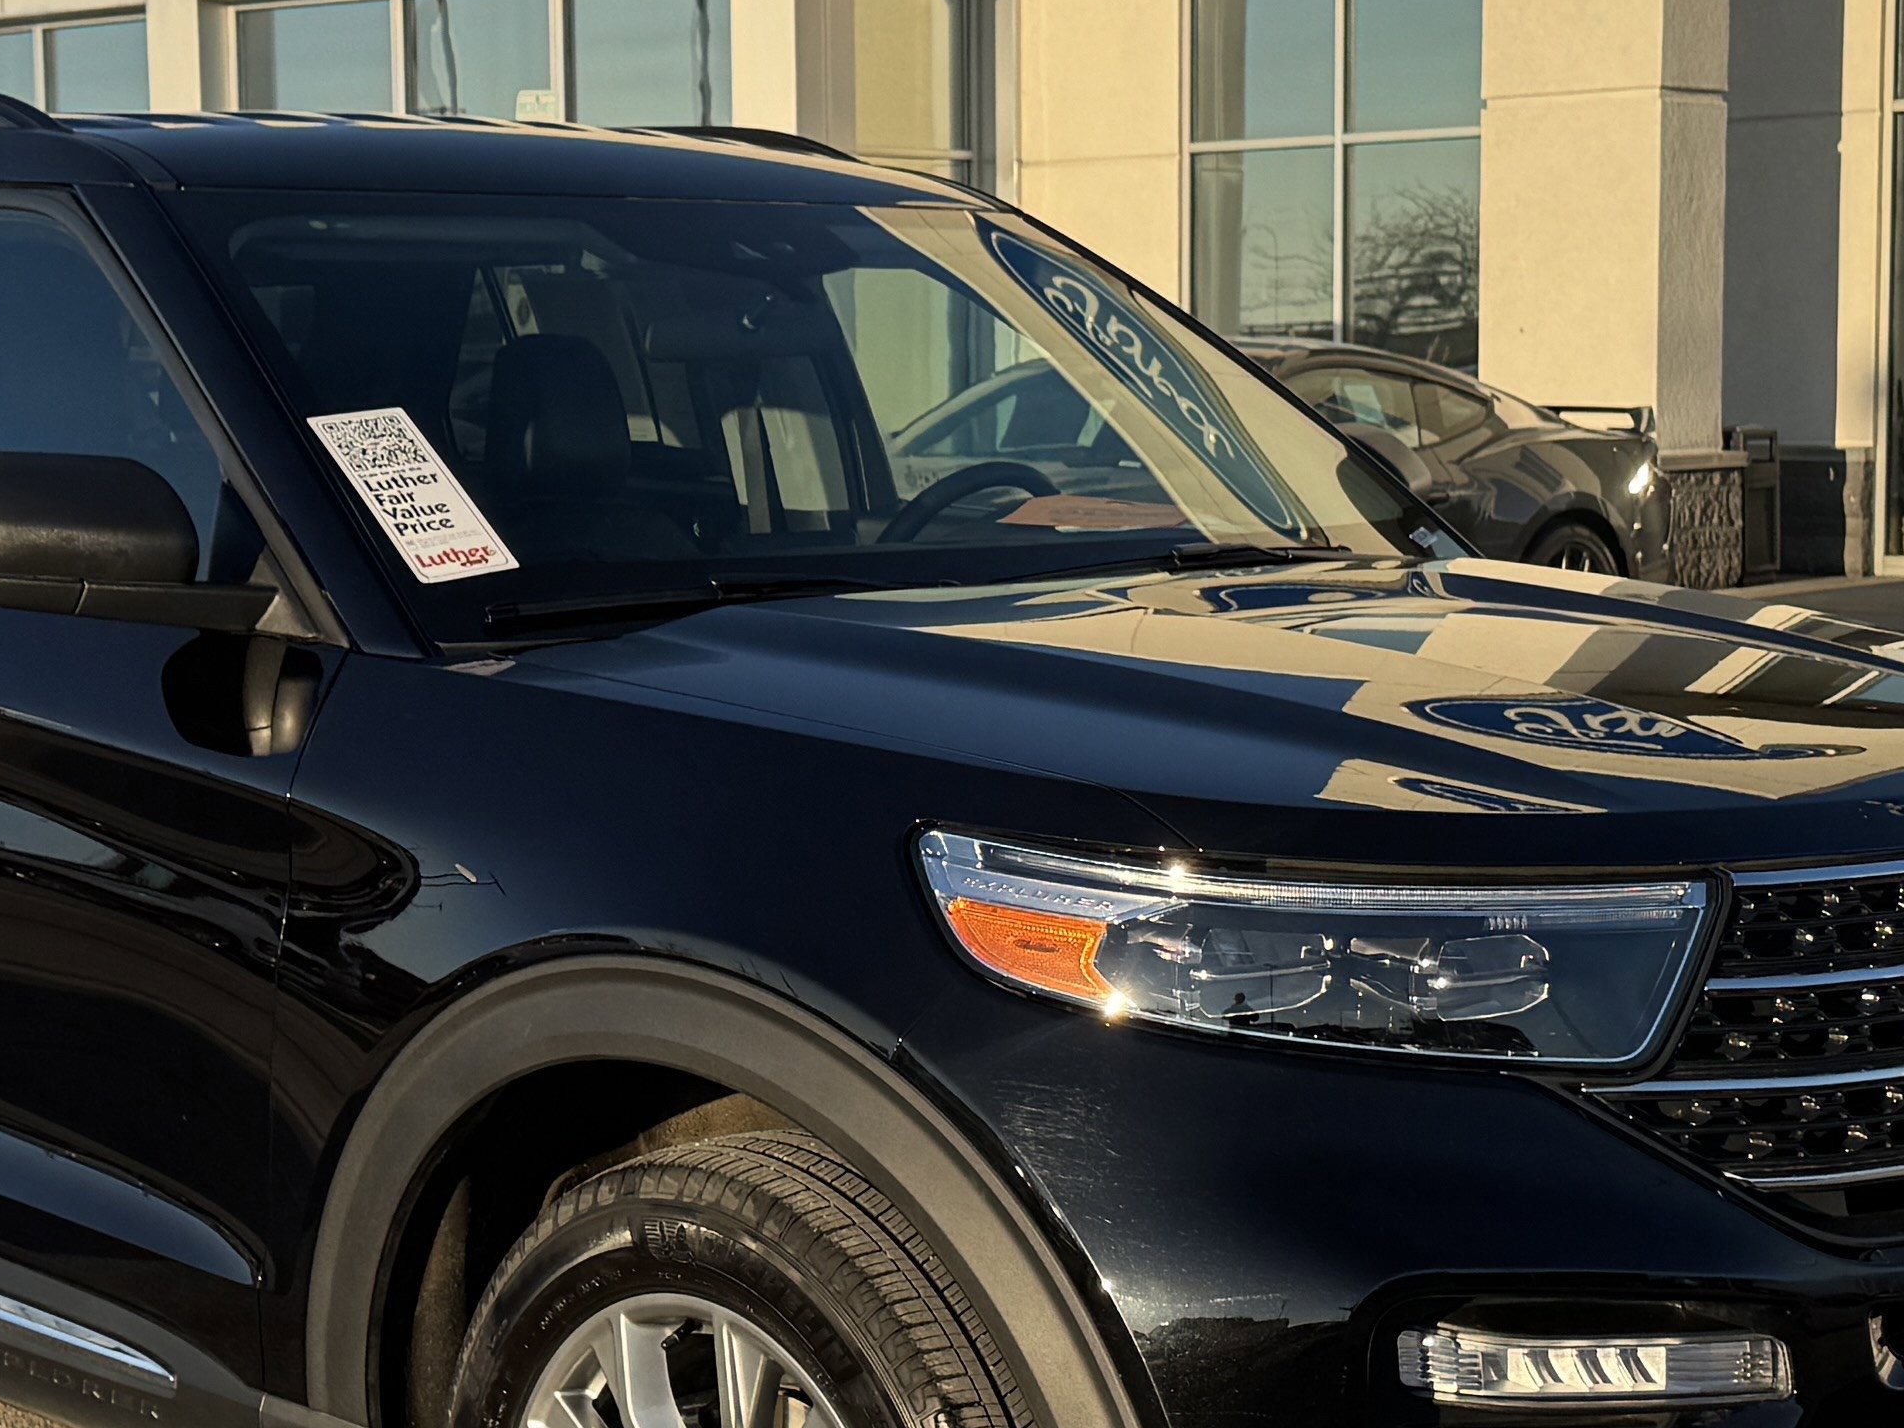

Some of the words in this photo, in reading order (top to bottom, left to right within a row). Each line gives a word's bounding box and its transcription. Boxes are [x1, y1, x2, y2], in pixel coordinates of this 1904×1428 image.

[363, 473, 438, 492] Luther
[373, 490, 415, 507] Fair
[382, 502, 450, 520] Value
[393, 518, 455, 537] Price
[415, 545, 492, 569] Luther
